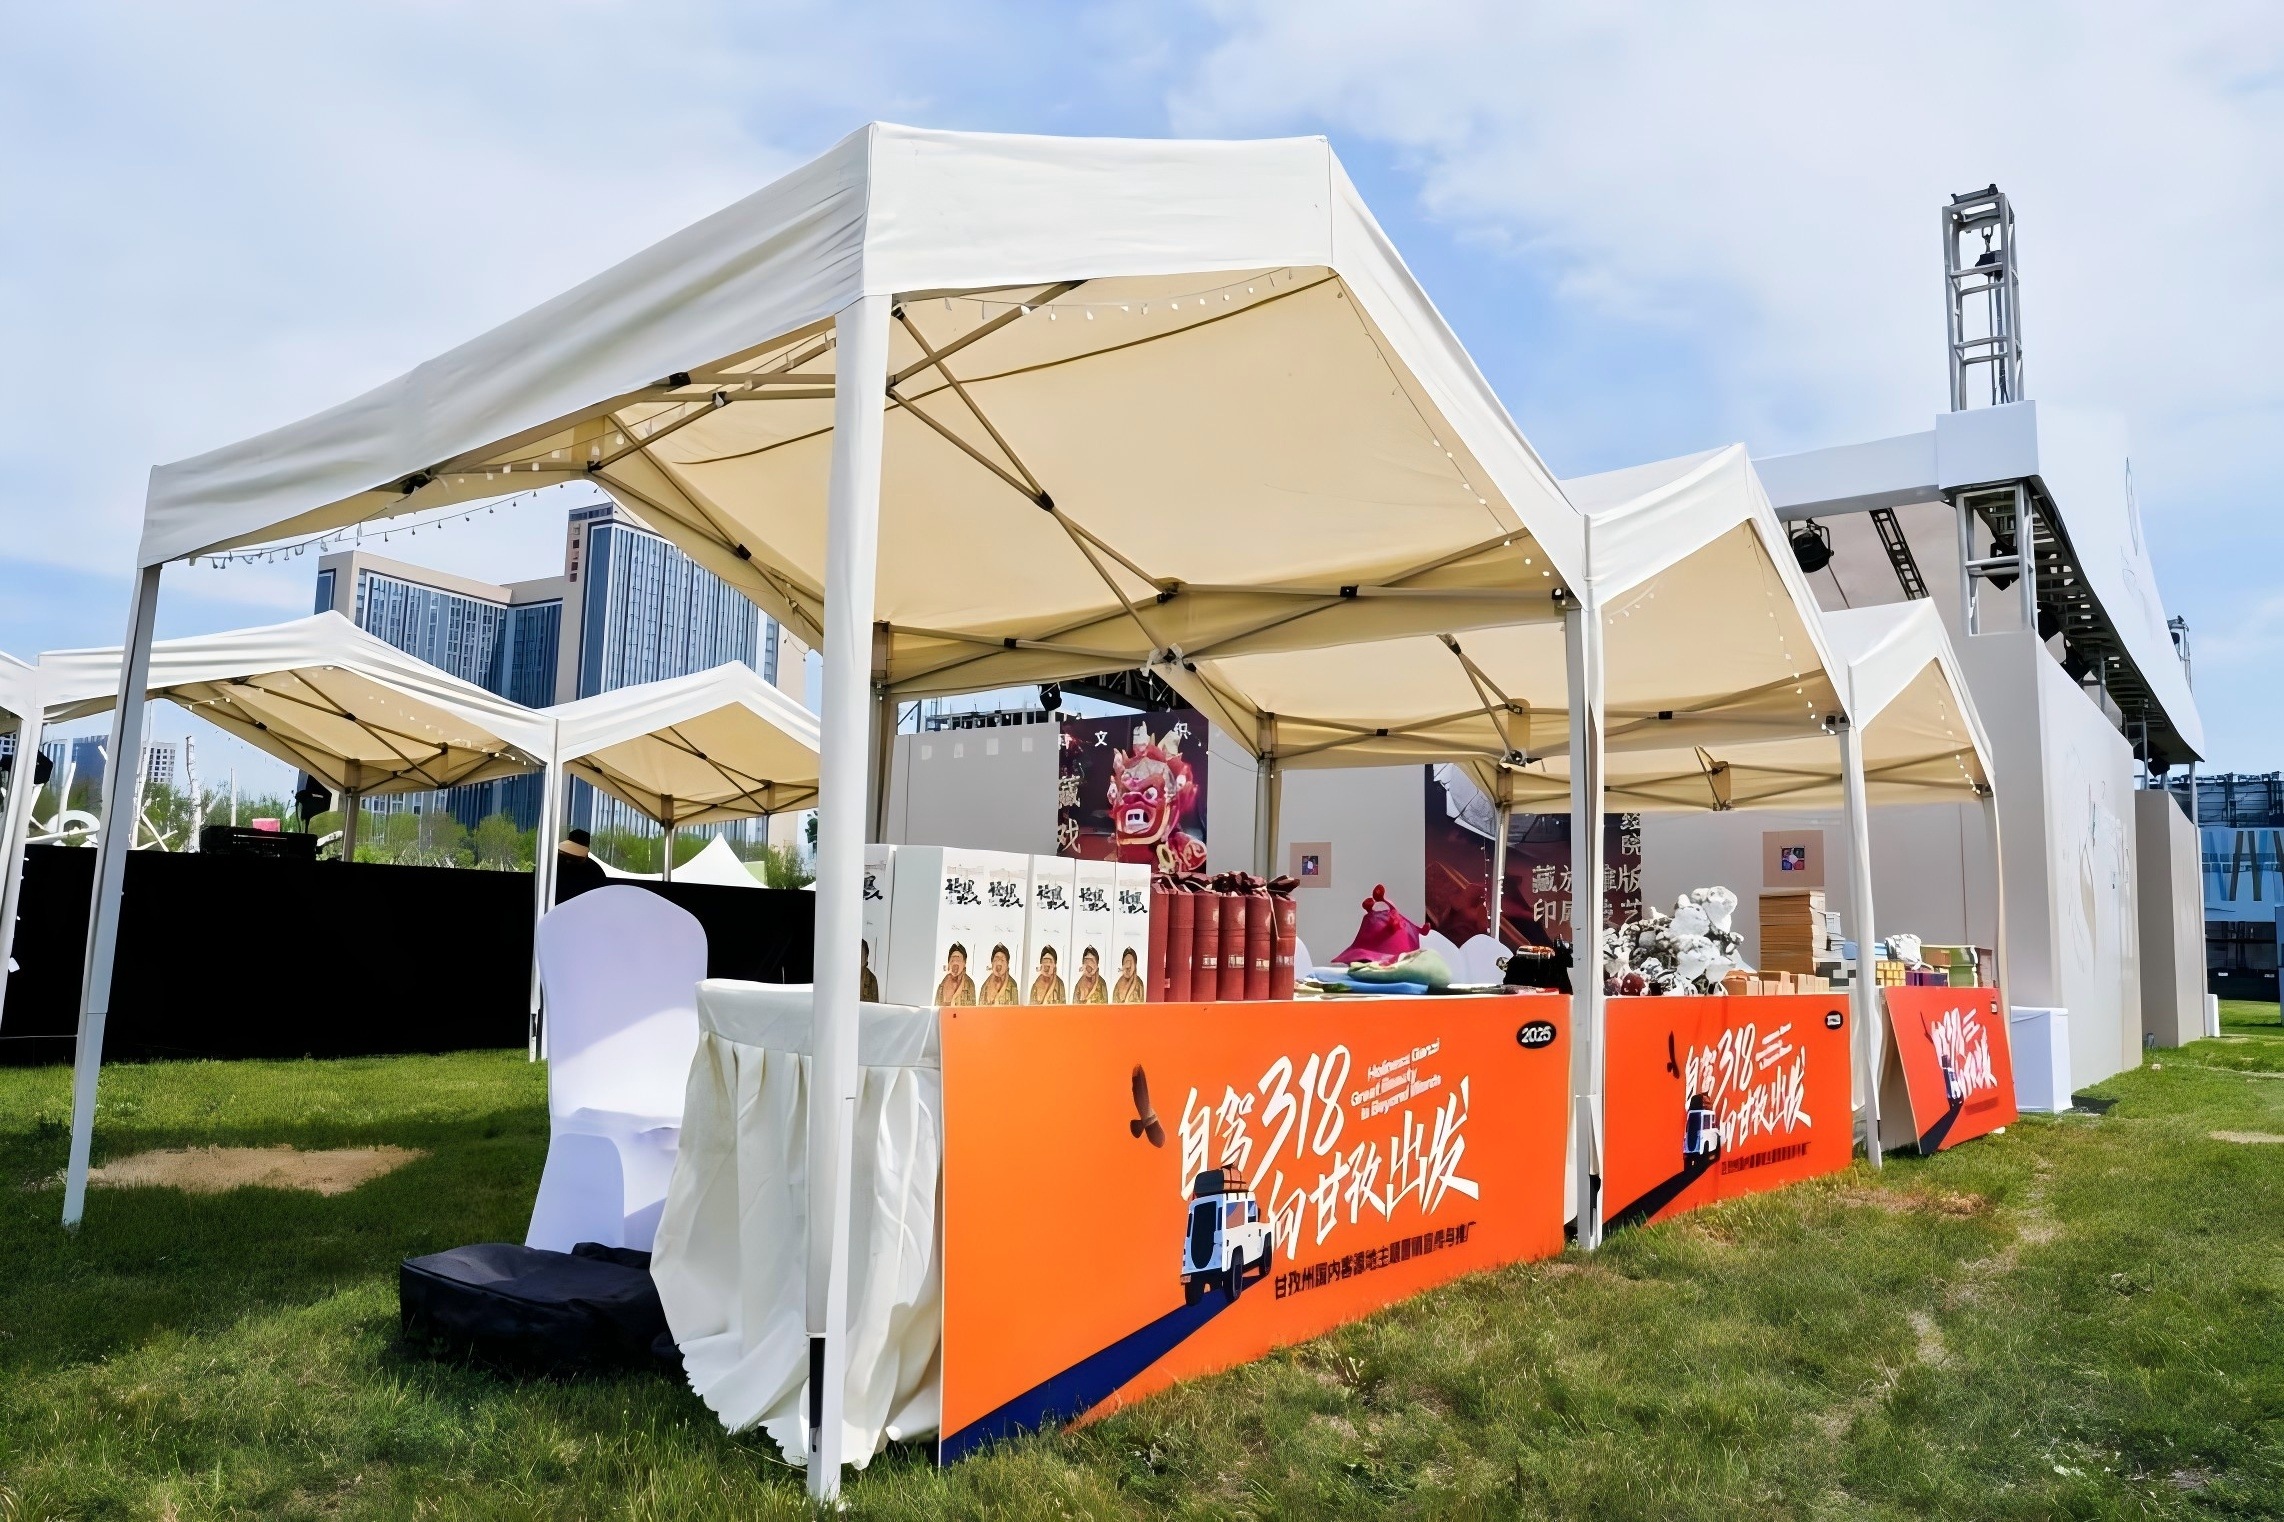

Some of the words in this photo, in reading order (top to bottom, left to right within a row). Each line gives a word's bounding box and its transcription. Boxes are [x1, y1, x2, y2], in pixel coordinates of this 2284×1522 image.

[1094, 730, 1108, 747] 文
[1521, 1025, 1552, 1043] 2025
[1268, 1075, 1479, 1260] 向甘孜出发
